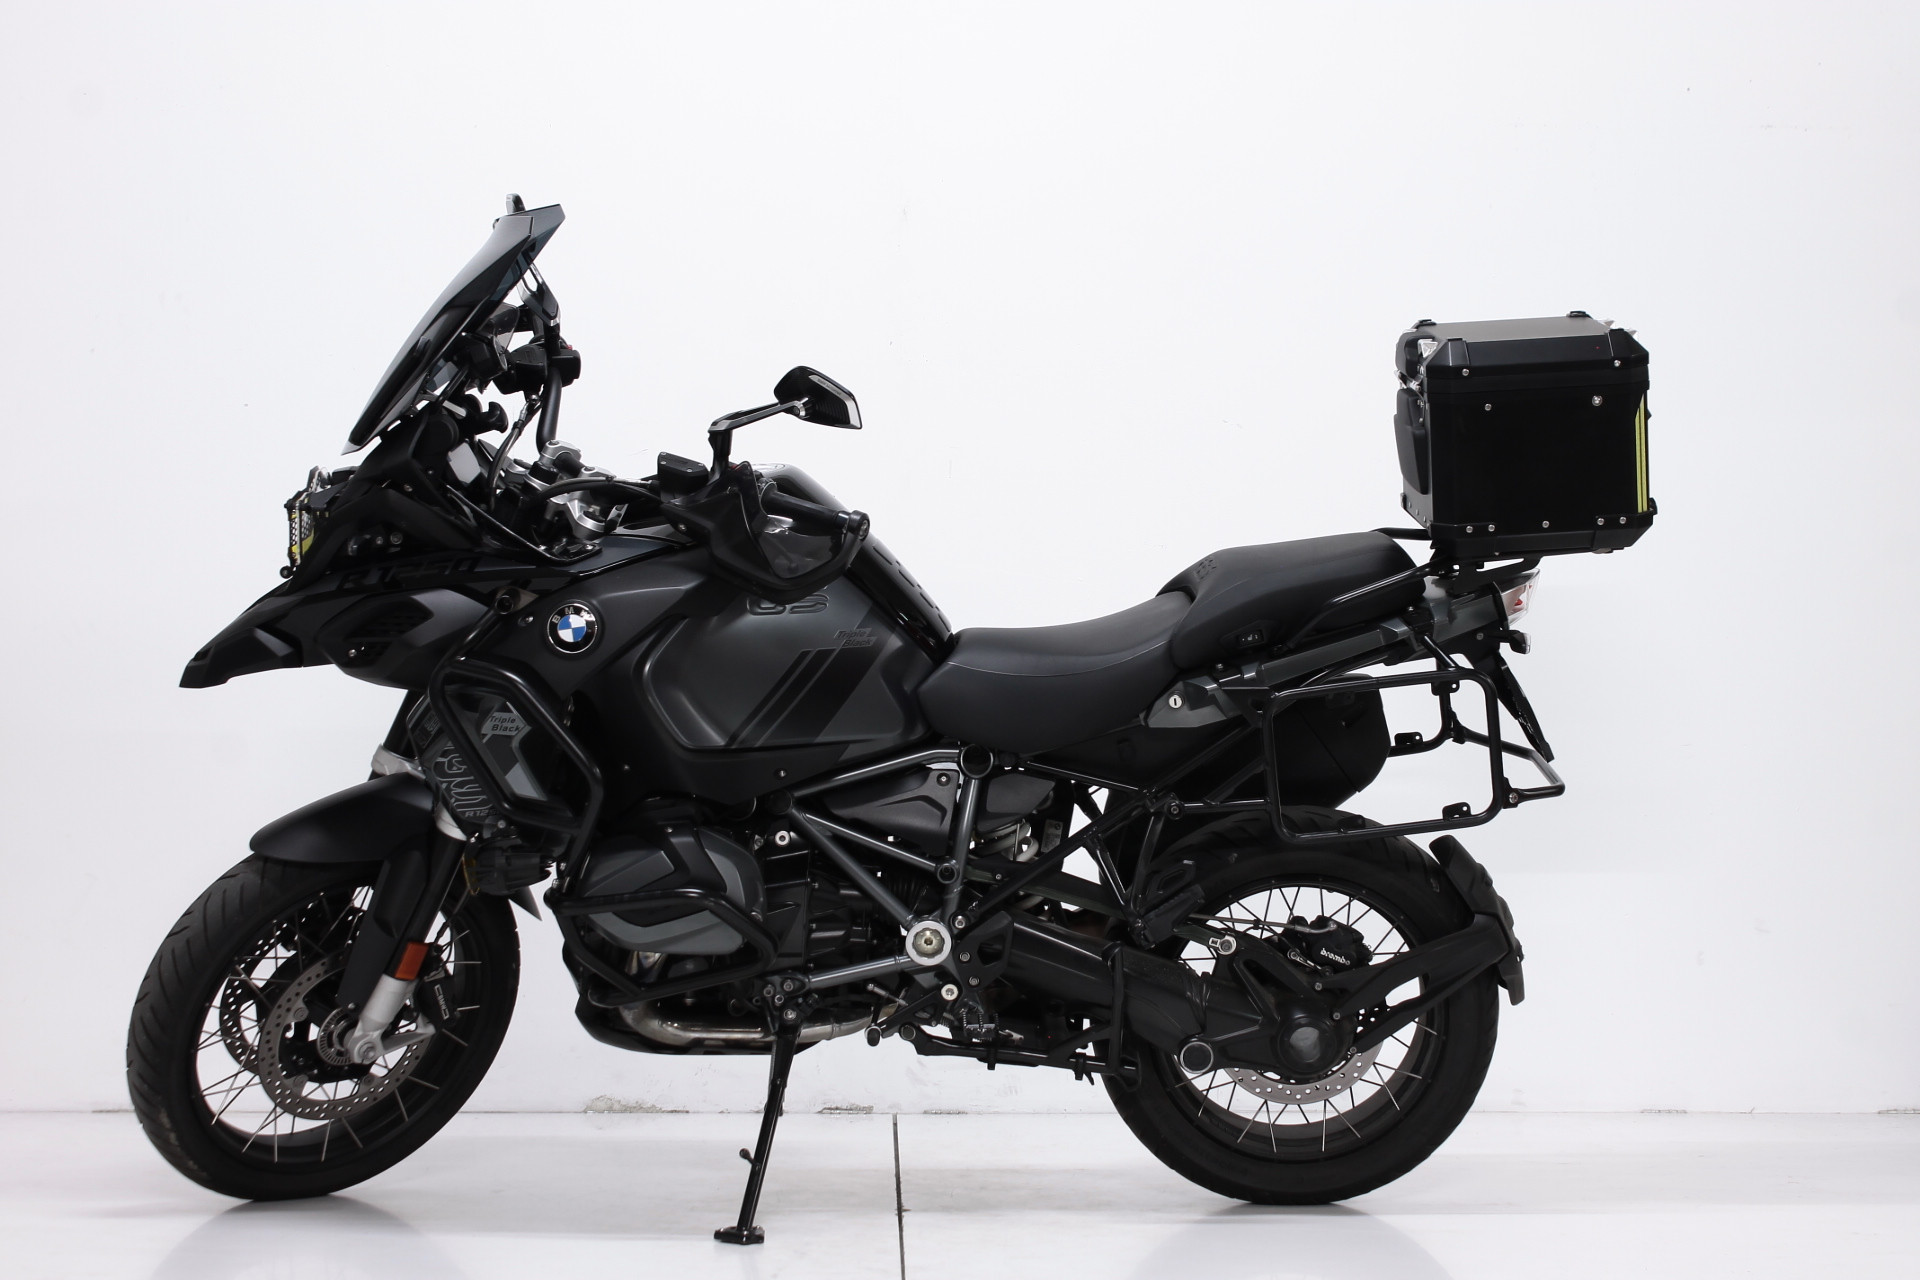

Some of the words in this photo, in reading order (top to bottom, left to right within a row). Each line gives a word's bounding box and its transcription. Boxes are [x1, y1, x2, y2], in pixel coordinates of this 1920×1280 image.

[551, 606, 594, 624] BMW
[842, 639, 872, 648] Black
[490, 715, 516, 724] Triple
[491, 724, 521, 732] Black
[1320, 947, 1351, 966] brembo
